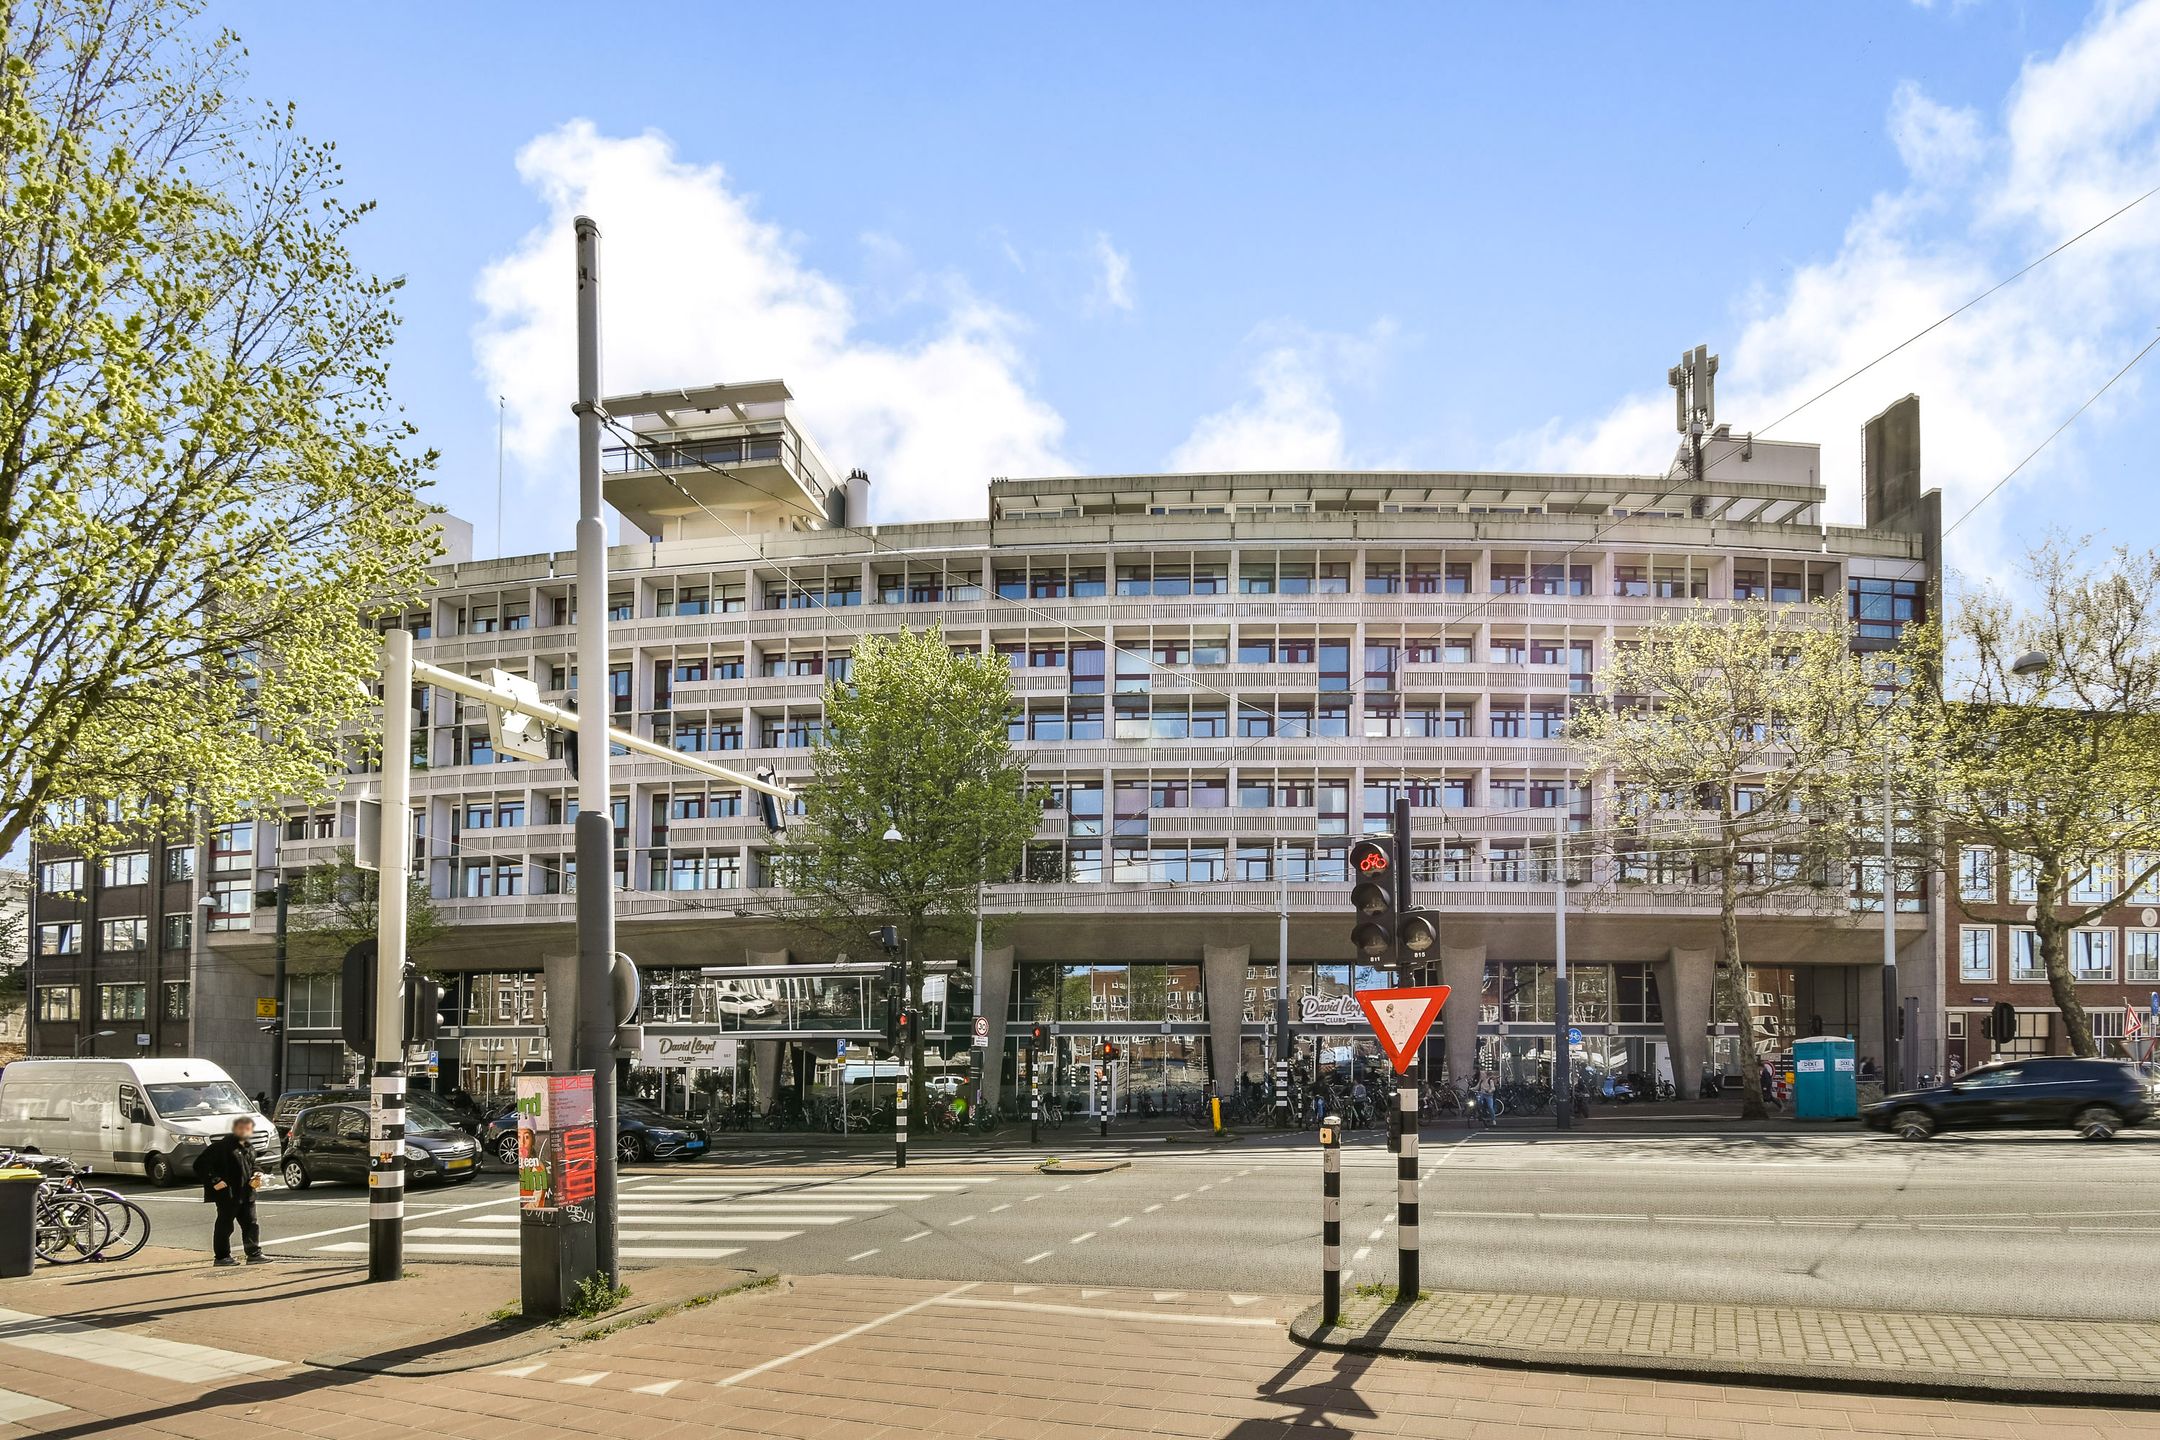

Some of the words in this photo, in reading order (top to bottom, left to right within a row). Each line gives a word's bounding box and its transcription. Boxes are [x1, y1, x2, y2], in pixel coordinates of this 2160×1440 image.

[1303, 997, 1340, 1016] David
[1340, 996, 1361, 1016] Lloy
[659, 1037, 691, 1054] David
[690, 1037, 717, 1054] Lloyd
